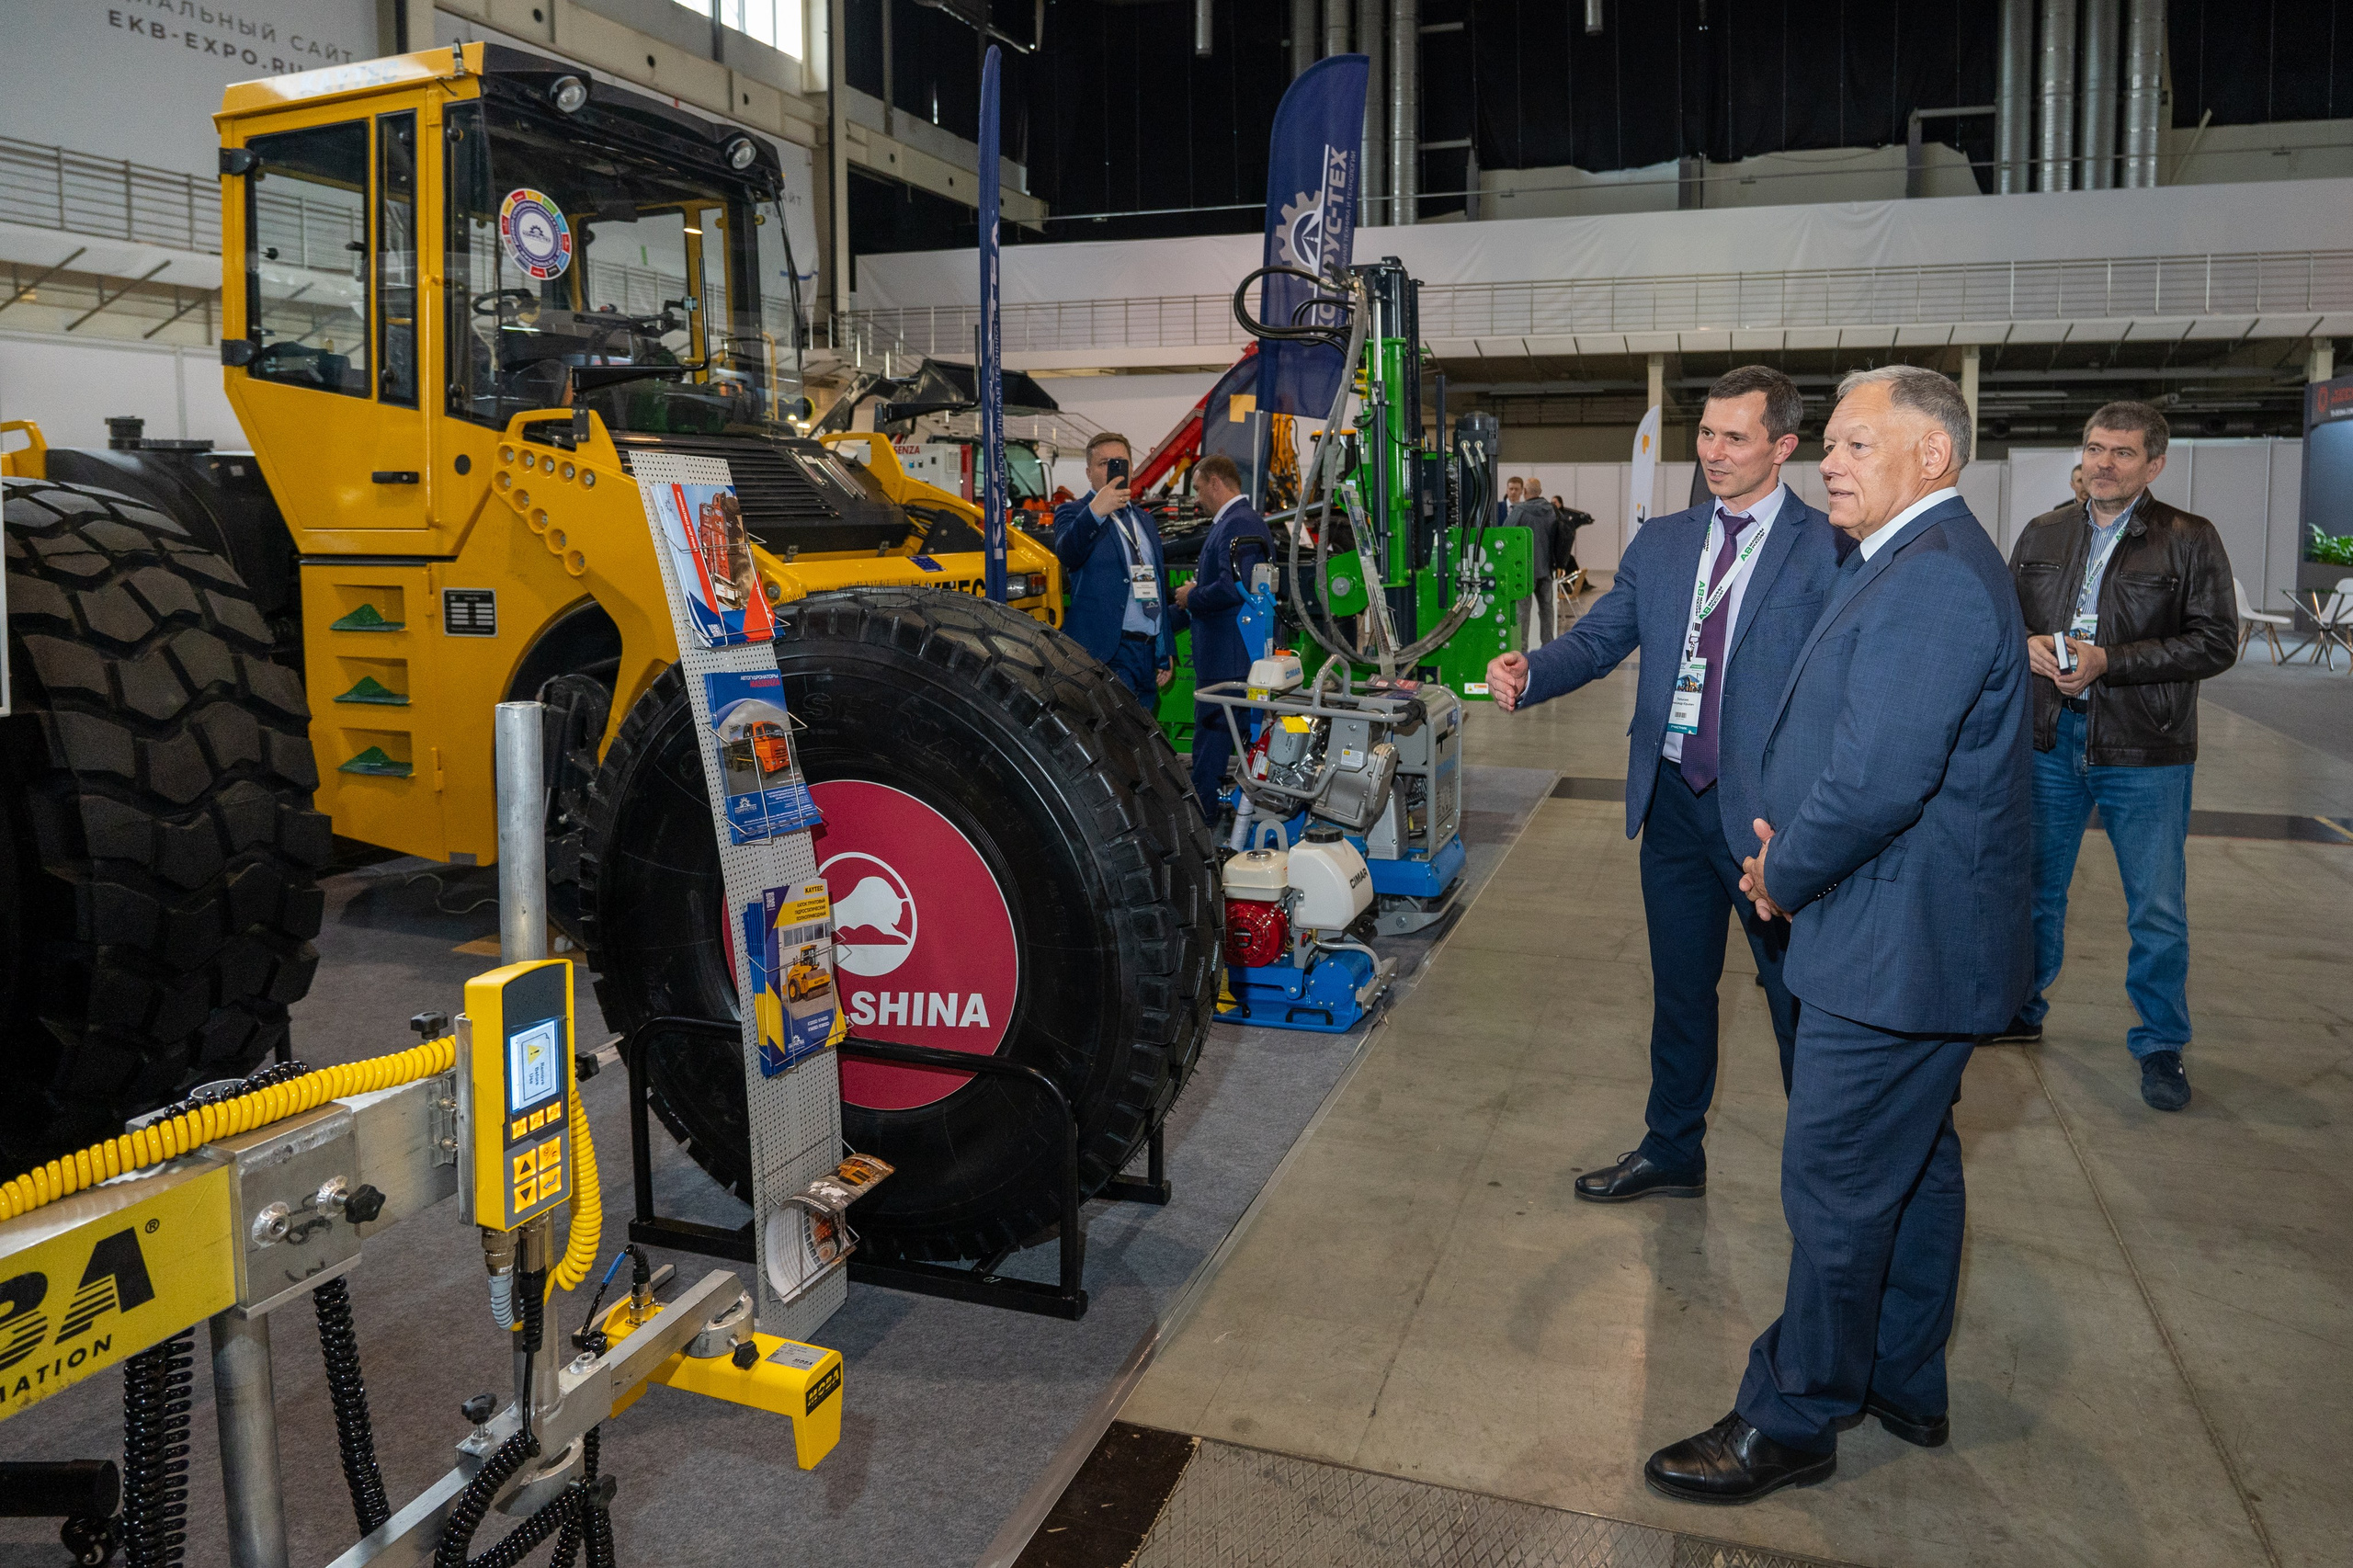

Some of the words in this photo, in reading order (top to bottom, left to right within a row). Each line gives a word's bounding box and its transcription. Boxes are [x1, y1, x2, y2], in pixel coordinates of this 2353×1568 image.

[138, 0, 276, 43] АЛЬНЫЙ
[290, 35, 354, 64] САЙТ
[804, 885, 824, 894] KAYTEC
[1349, 867, 1369, 890] CIMAR
[847, 991, 990, 1028] SHINA
[516, 1122, 525, 1133] F1
[532, 1115, 541, 1125] F2
[550, 1107, 559, 1117] F3
[807, 1369, 839, 1407] MOBA
